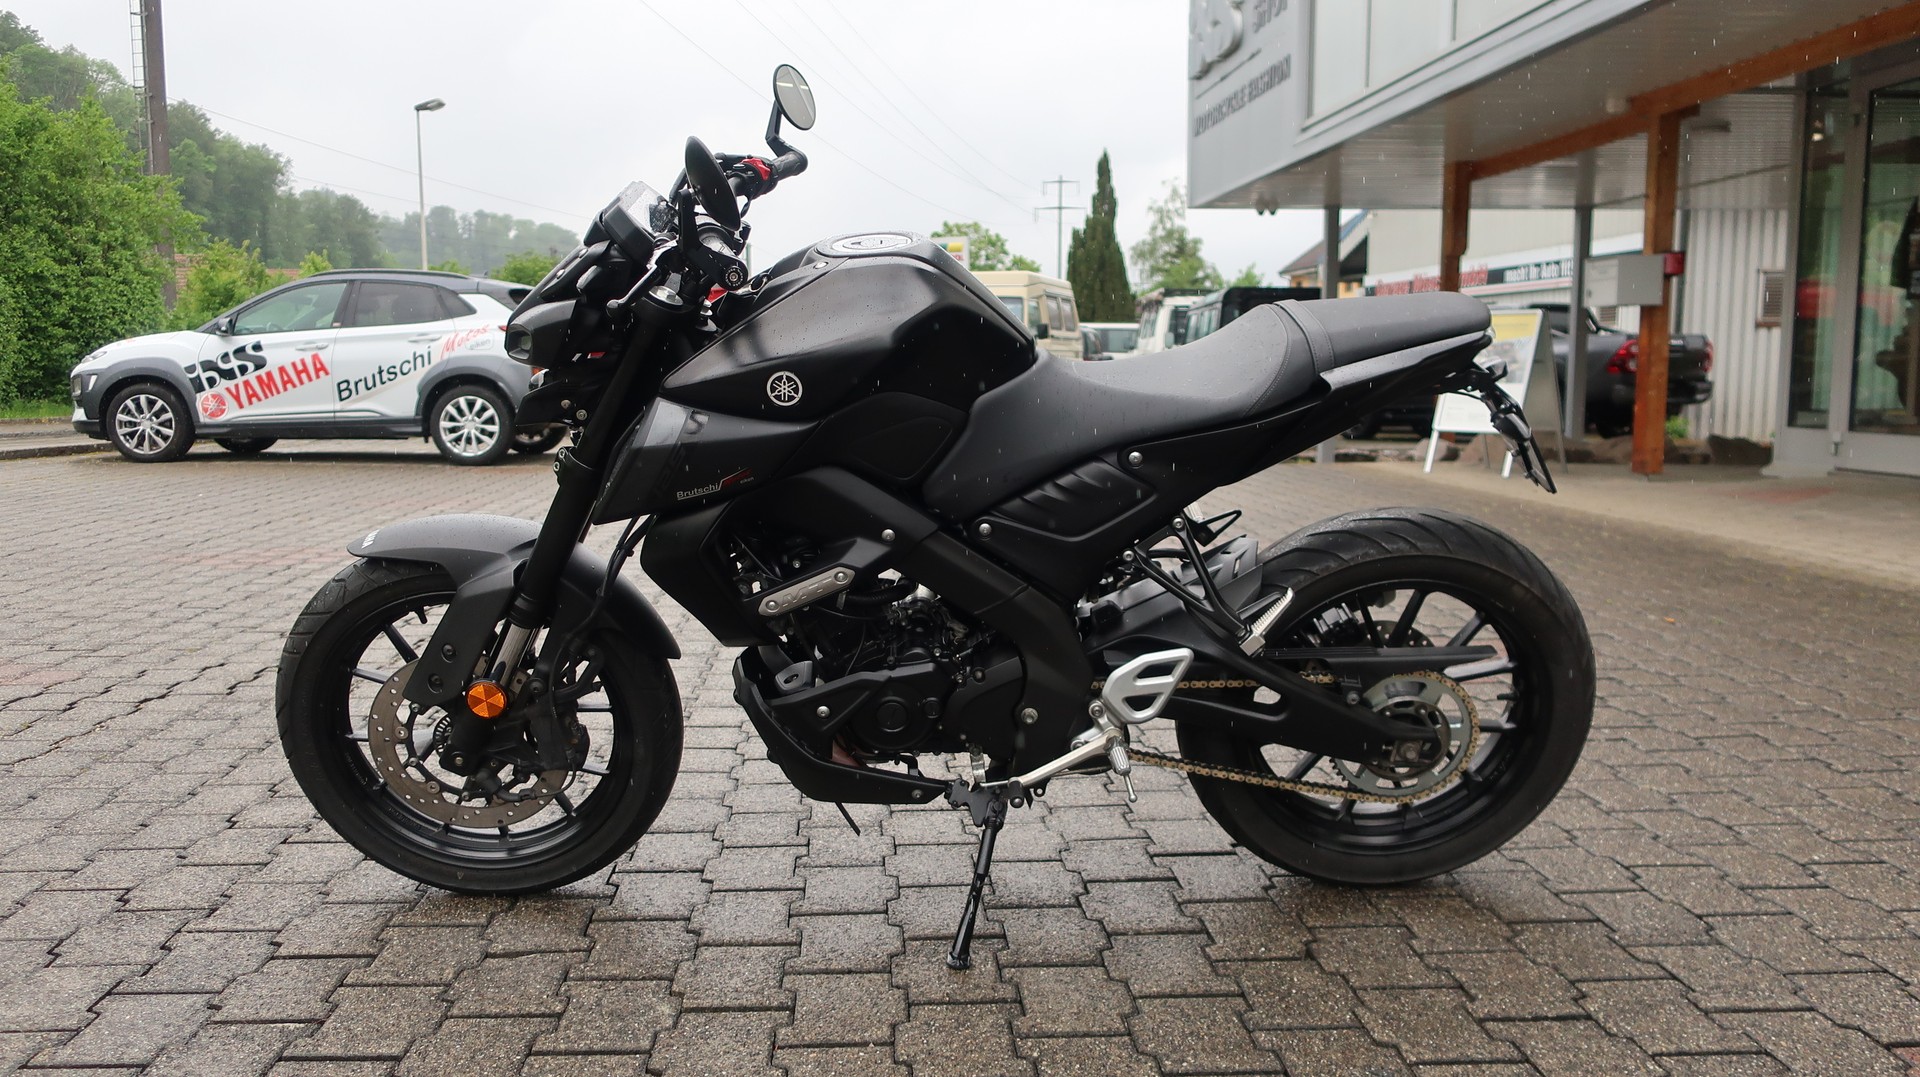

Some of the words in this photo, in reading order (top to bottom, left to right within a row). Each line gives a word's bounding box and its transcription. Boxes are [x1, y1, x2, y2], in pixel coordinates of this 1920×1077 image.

[225, 352, 330, 409] YAMAHA
[336, 346, 431, 402] Brutschi
[676, 482, 718, 499] Brutschi
